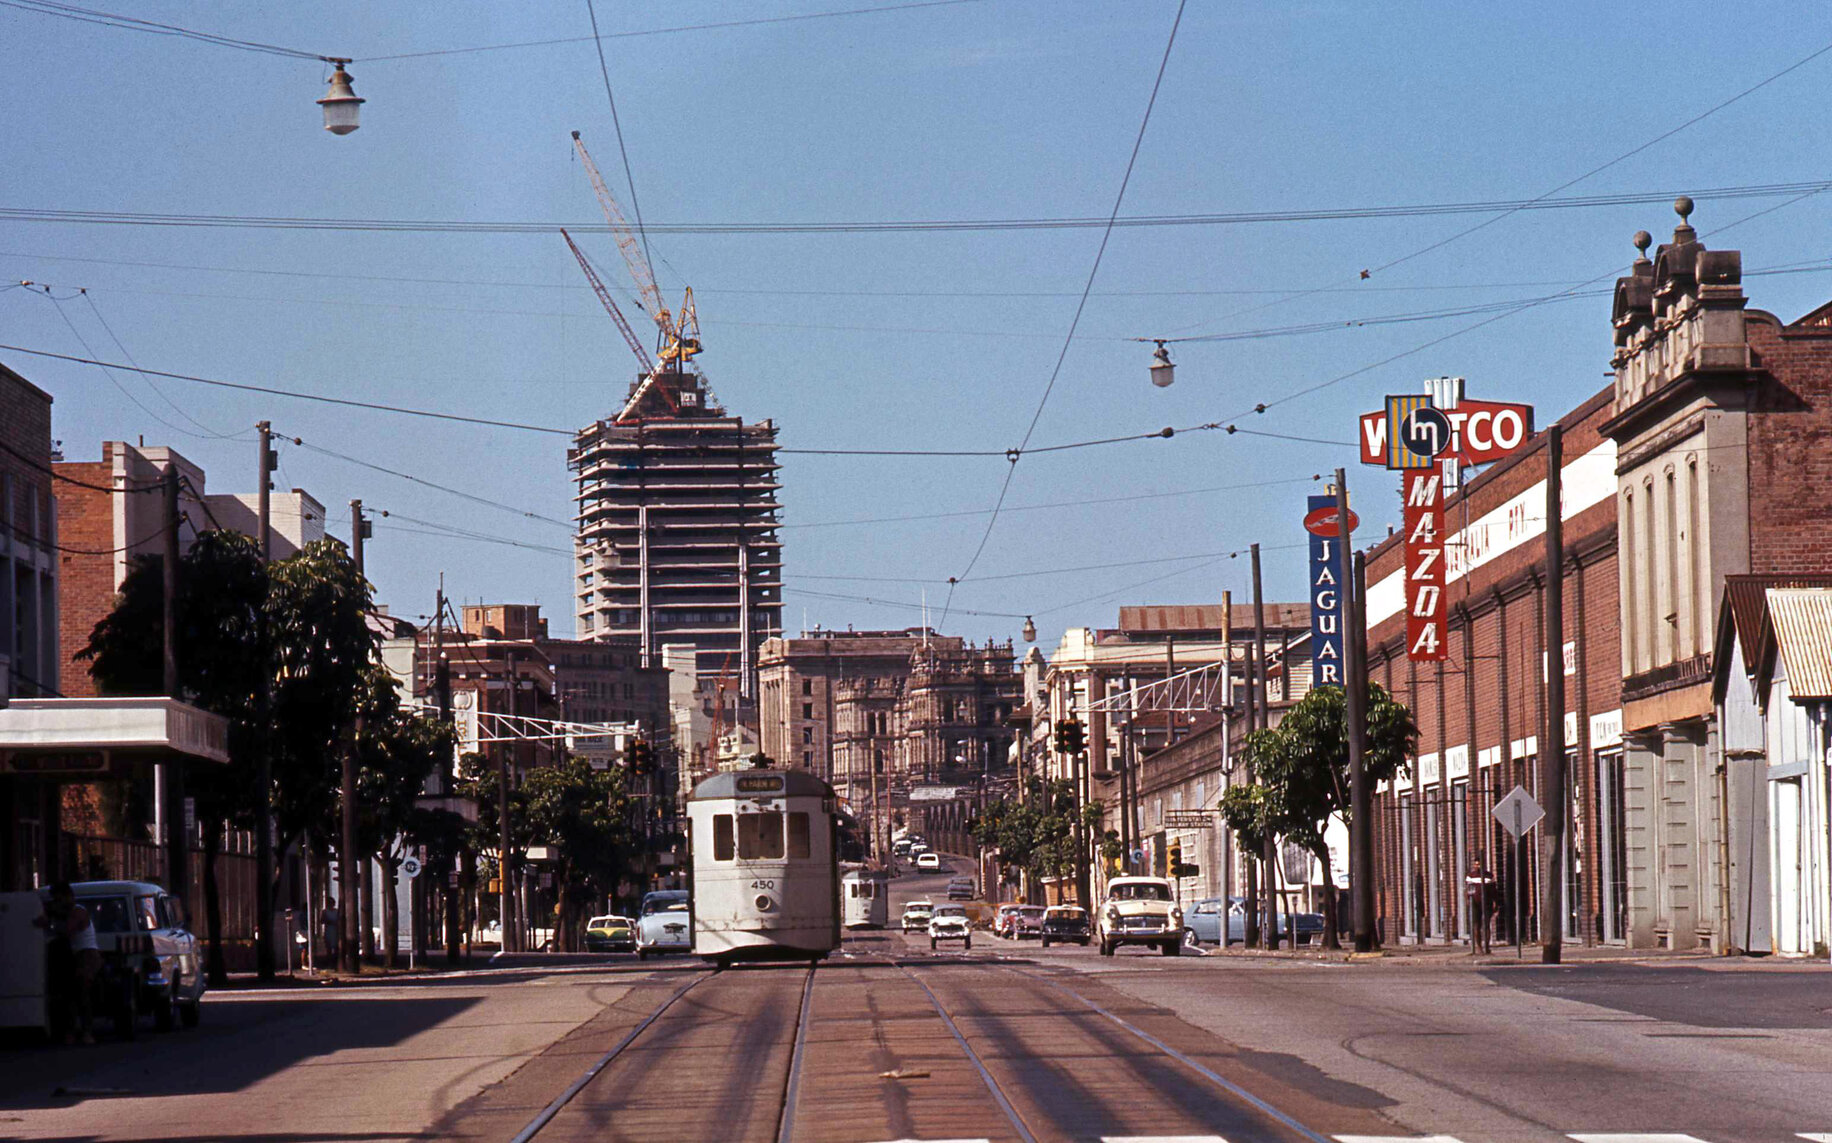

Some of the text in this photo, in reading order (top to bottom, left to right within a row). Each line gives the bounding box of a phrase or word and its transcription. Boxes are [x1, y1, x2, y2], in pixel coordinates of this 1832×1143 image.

[1364, 409, 1524, 457] WTCO
[1315, 540, 1340, 683] JAGUAR
[1408, 475, 1441, 654] MAZDA
[751, 880, 774, 889] 450
